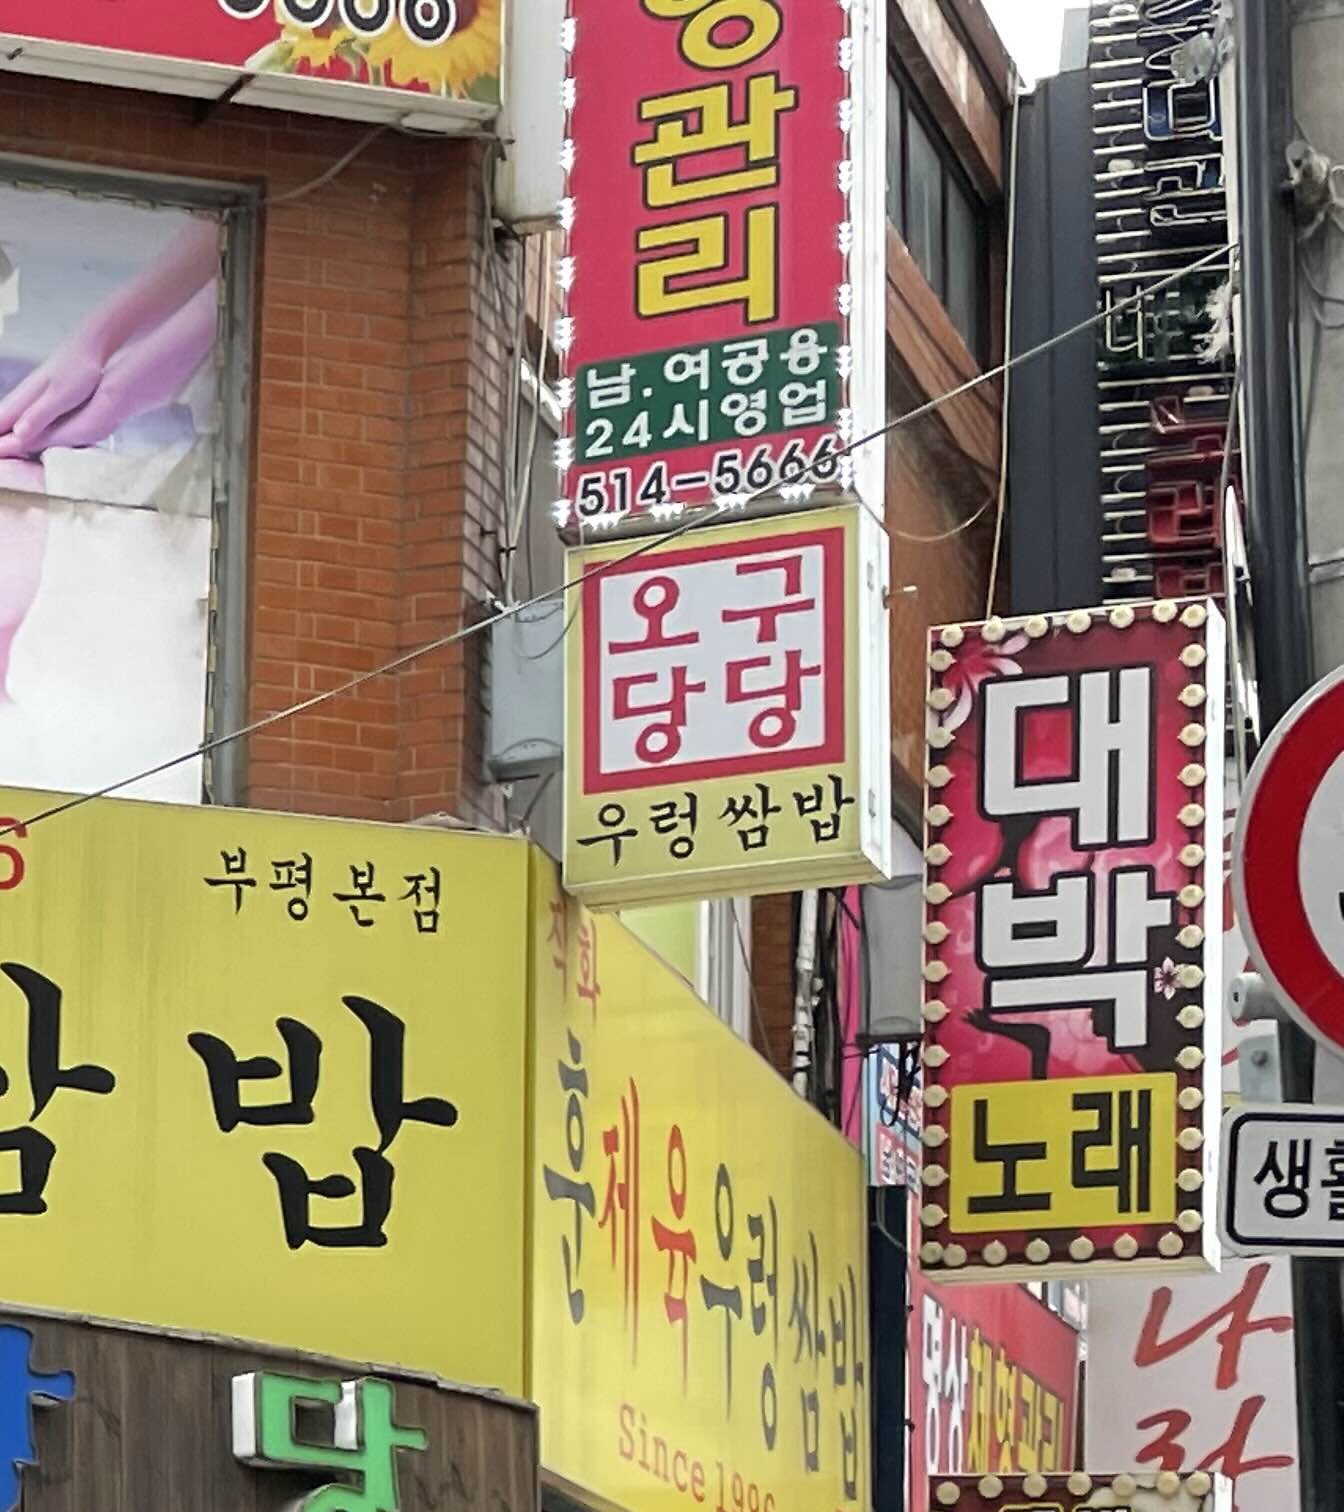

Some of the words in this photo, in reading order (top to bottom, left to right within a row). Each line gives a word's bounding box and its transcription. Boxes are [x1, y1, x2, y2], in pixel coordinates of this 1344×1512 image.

[578, 438, 840, 517] 514-5666
[203, 847, 443, 935] 부평본점
[968, 1089, 1153, 1214] 노래
[617, 1403, 706, 1503] Since
